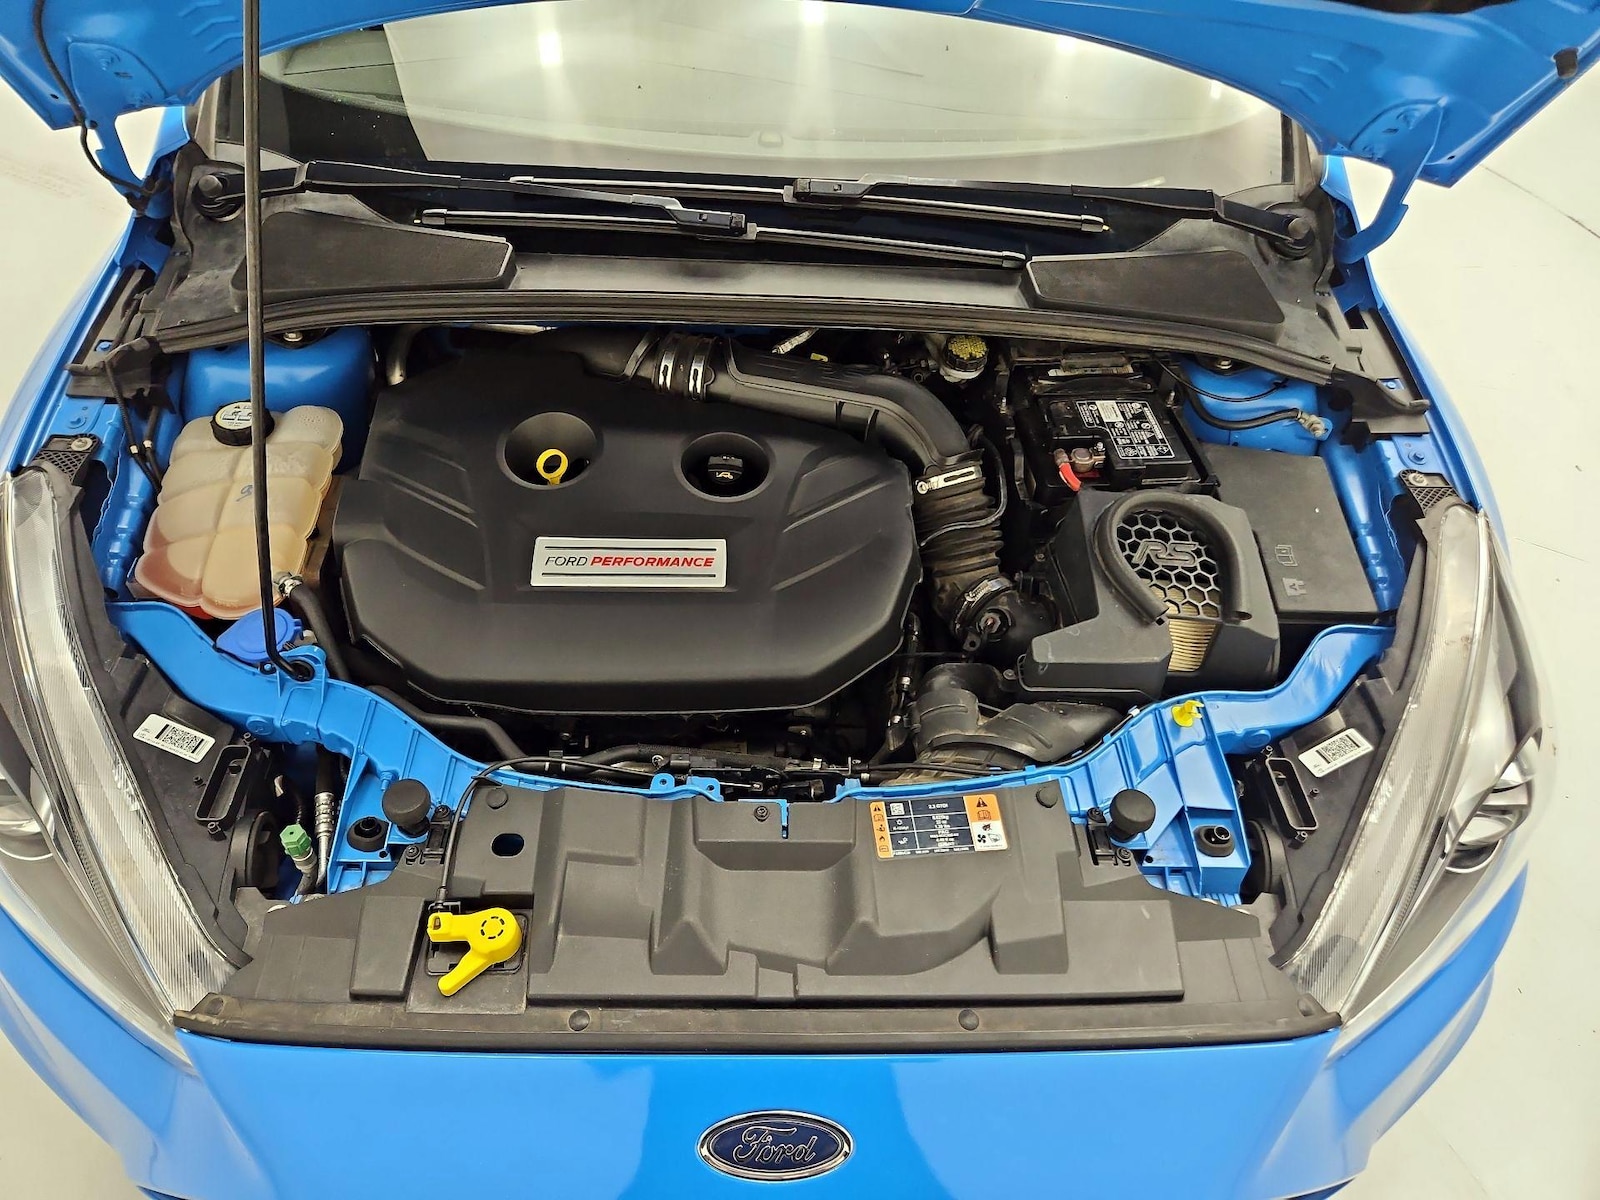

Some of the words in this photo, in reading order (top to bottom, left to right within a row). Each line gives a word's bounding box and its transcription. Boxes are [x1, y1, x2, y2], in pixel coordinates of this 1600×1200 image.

[545, 556, 588, 567] FORD
[590, 556, 715, 567] PERFORMANCE
[1131, 539, 1199, 567] RS
[732, 1125, 819, 1165] Ford
